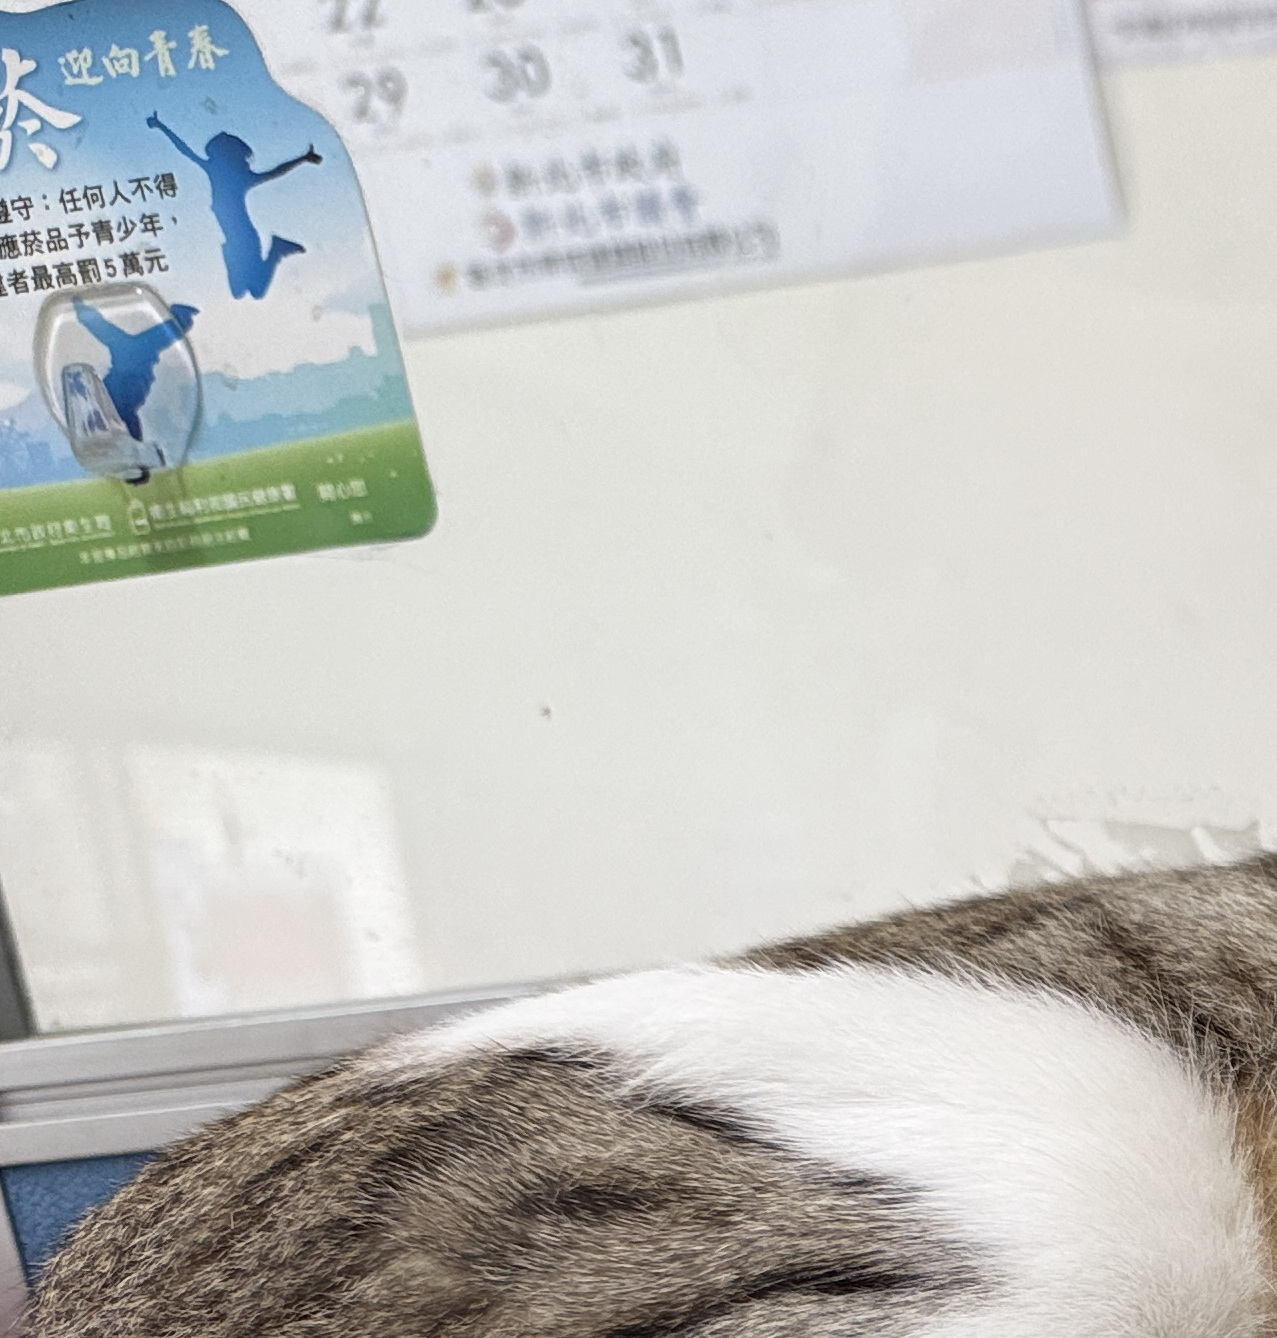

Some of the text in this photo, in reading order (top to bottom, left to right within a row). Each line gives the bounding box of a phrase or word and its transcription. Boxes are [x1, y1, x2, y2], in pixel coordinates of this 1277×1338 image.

[57, 24, 229, 86] 迎向青春
[482, 44, 552, 104] 30
[622, 25, 684, 85] 31
